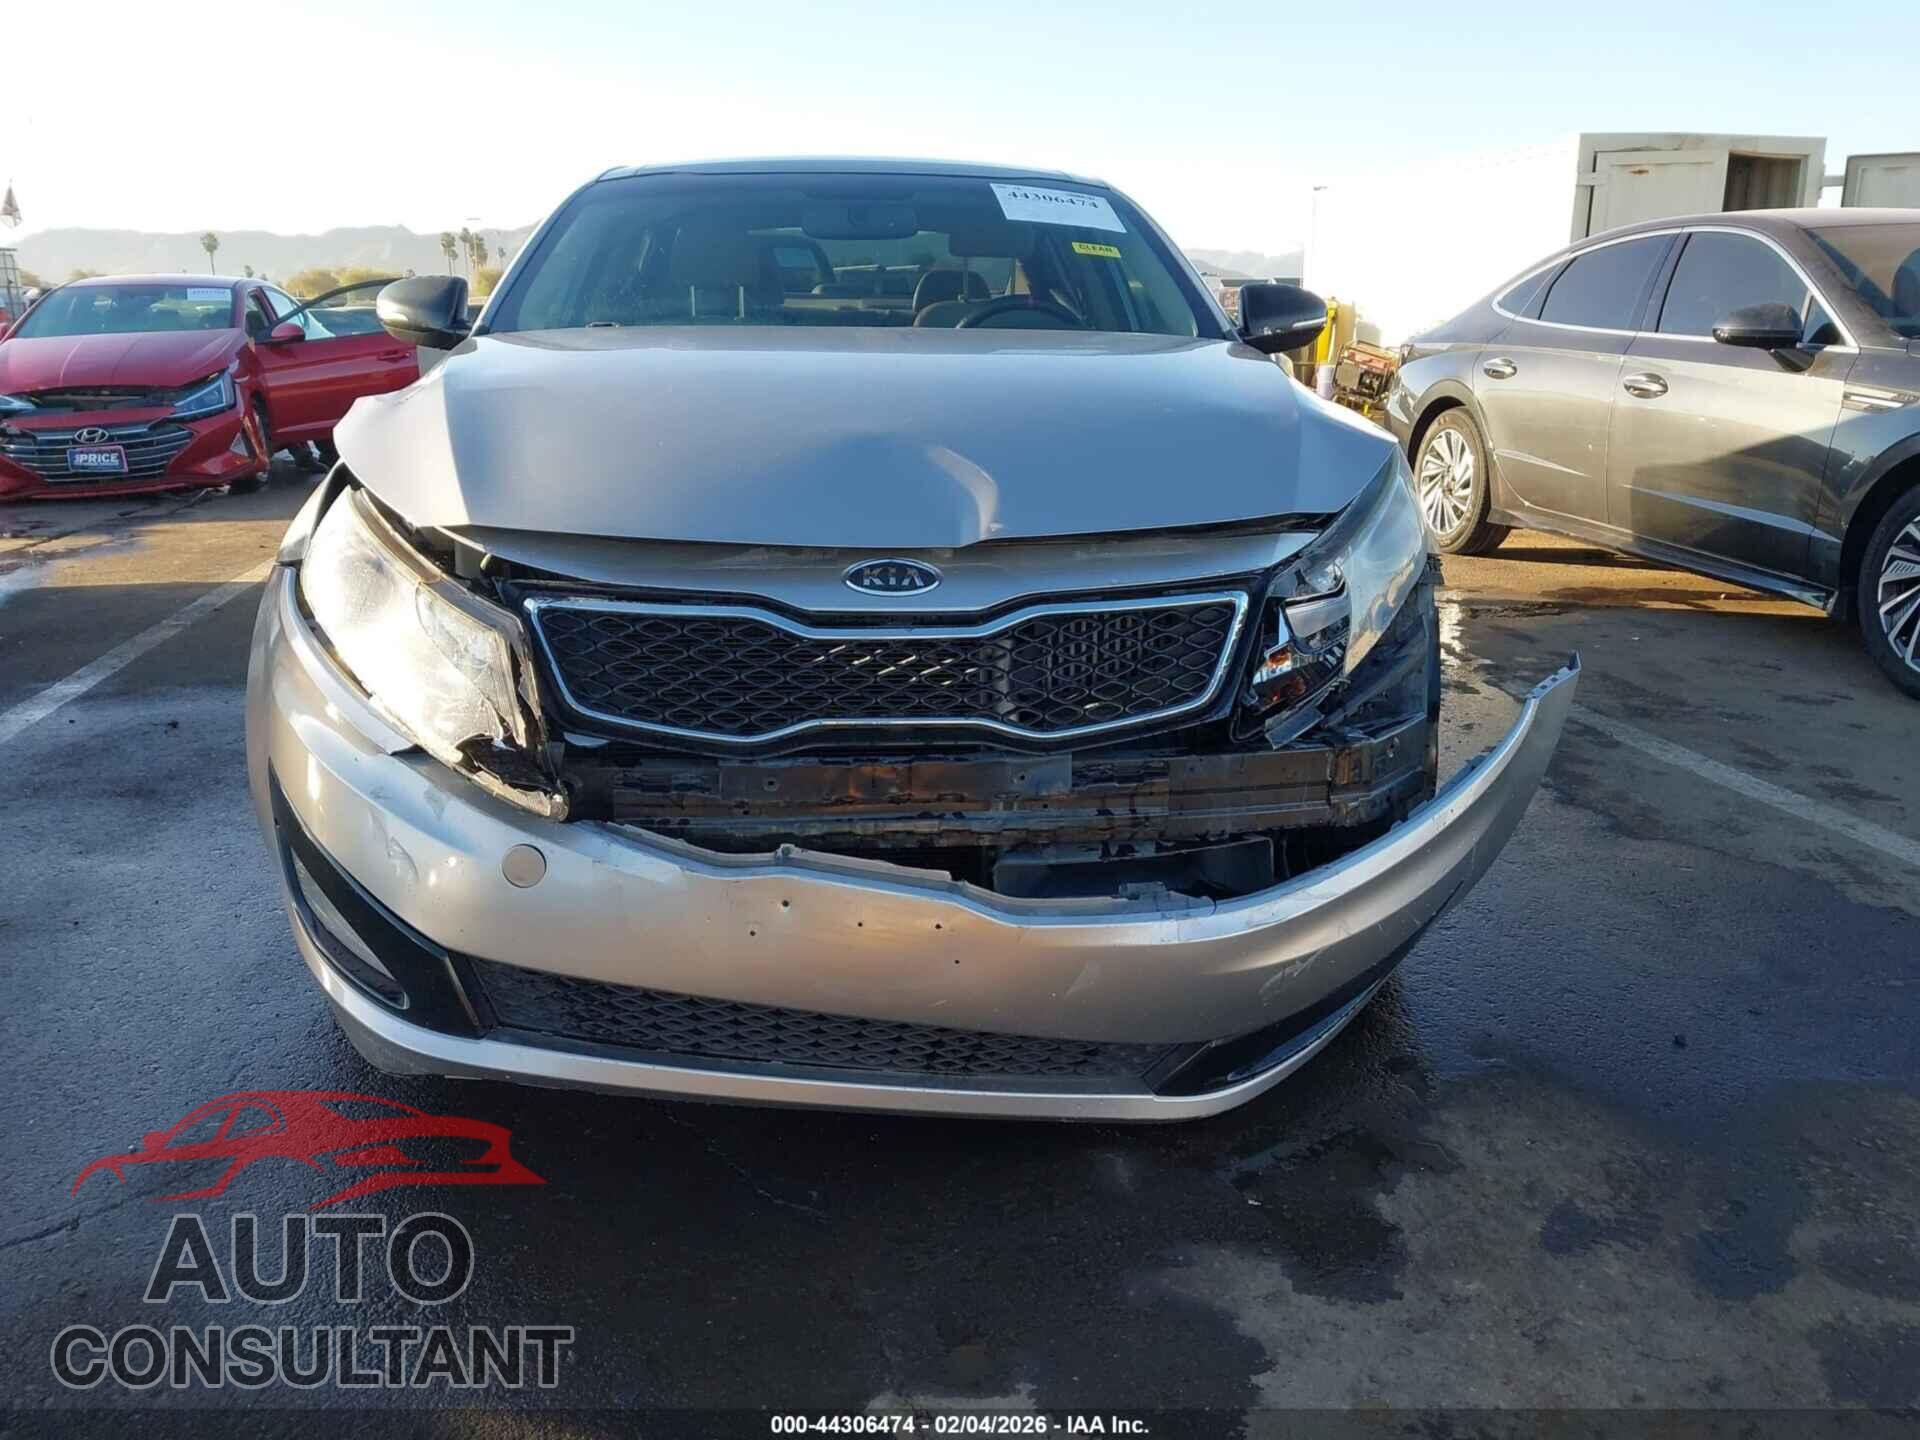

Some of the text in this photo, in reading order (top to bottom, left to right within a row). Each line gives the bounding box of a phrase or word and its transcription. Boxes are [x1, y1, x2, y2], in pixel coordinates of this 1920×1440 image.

[1008, 191, 1099, 209] 44306474
[80, 453, 119, 464] PRICE
[862, 567, 925, 587] KIA
